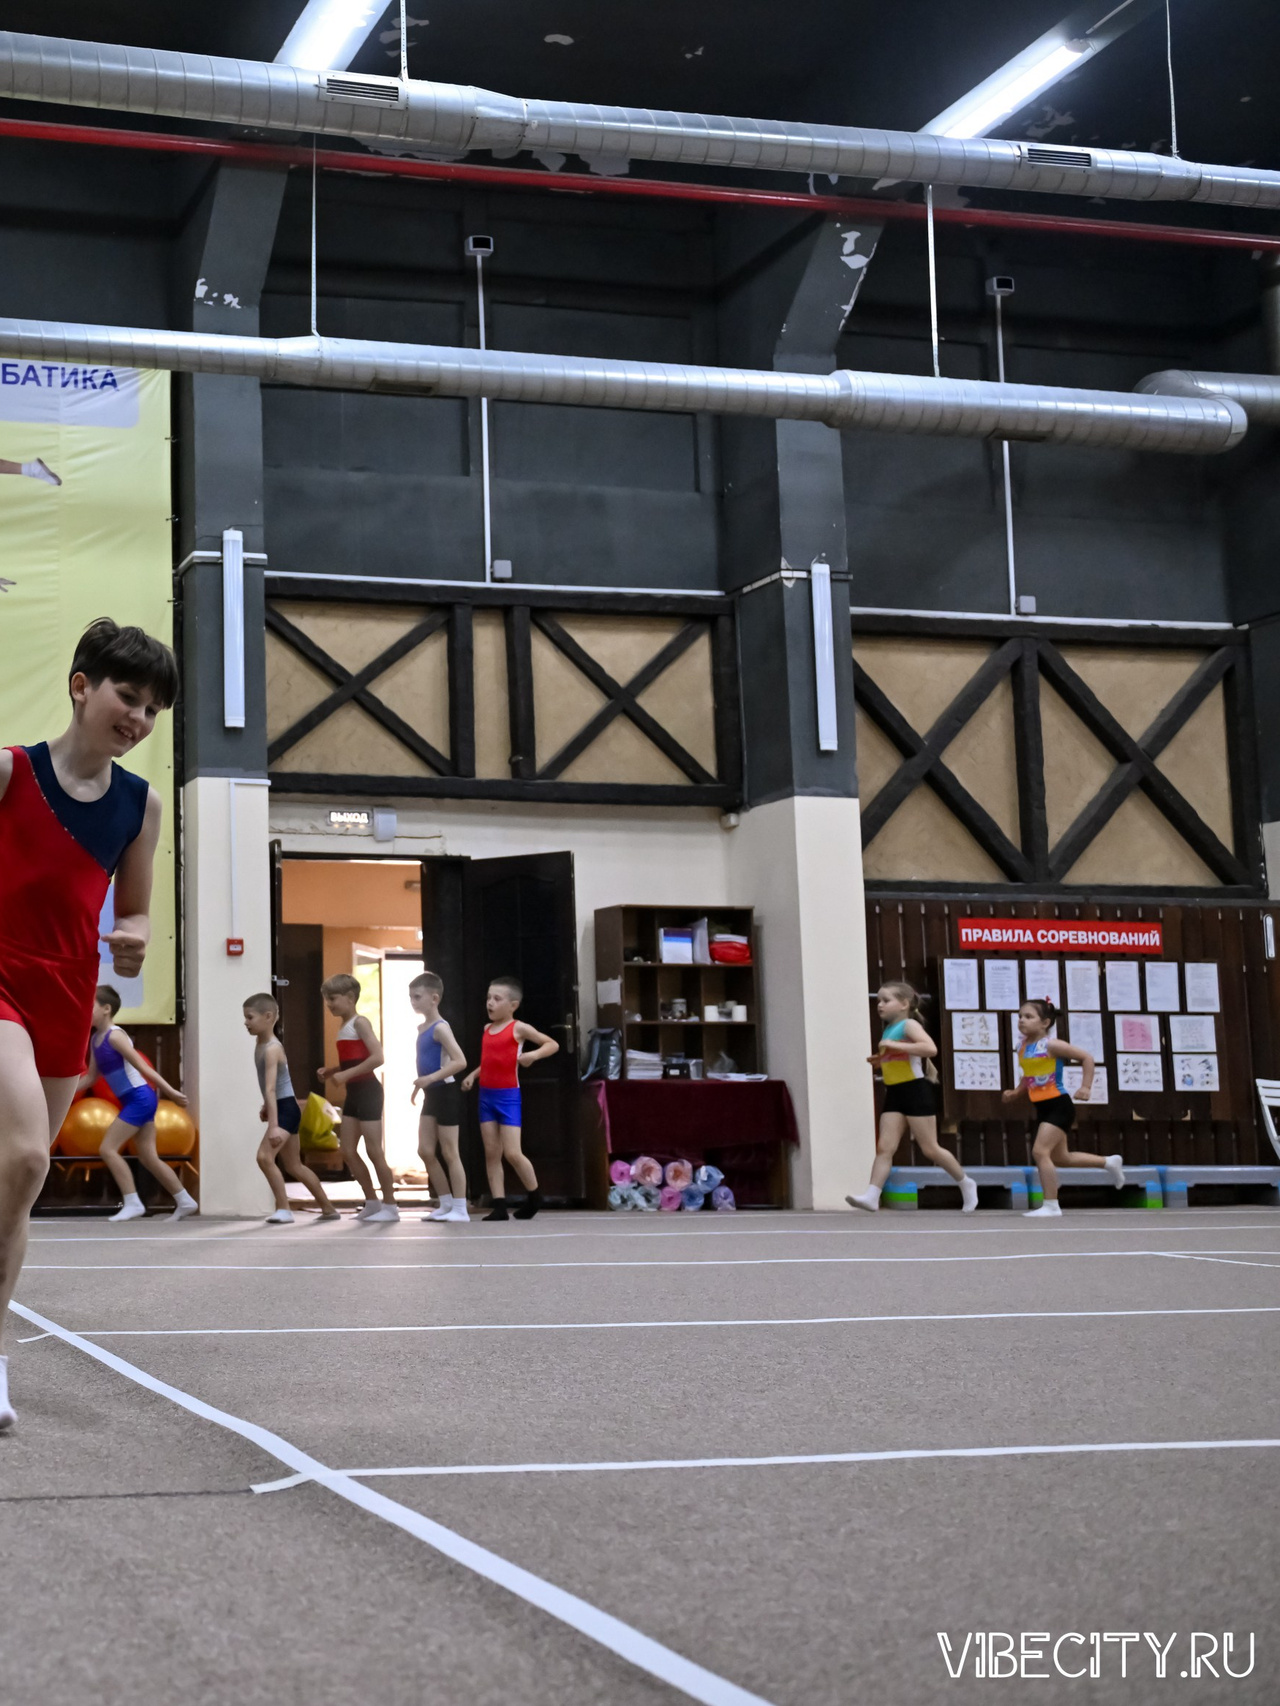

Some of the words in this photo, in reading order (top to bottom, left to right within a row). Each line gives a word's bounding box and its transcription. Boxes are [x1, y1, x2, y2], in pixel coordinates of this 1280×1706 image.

[330, 811, 369, 824] ВЫХОД
[961, 928, 1034, 943] ПРАВИЛА
[1037, 929, 1160, 946] СОРЕВНОВАНИЙ
